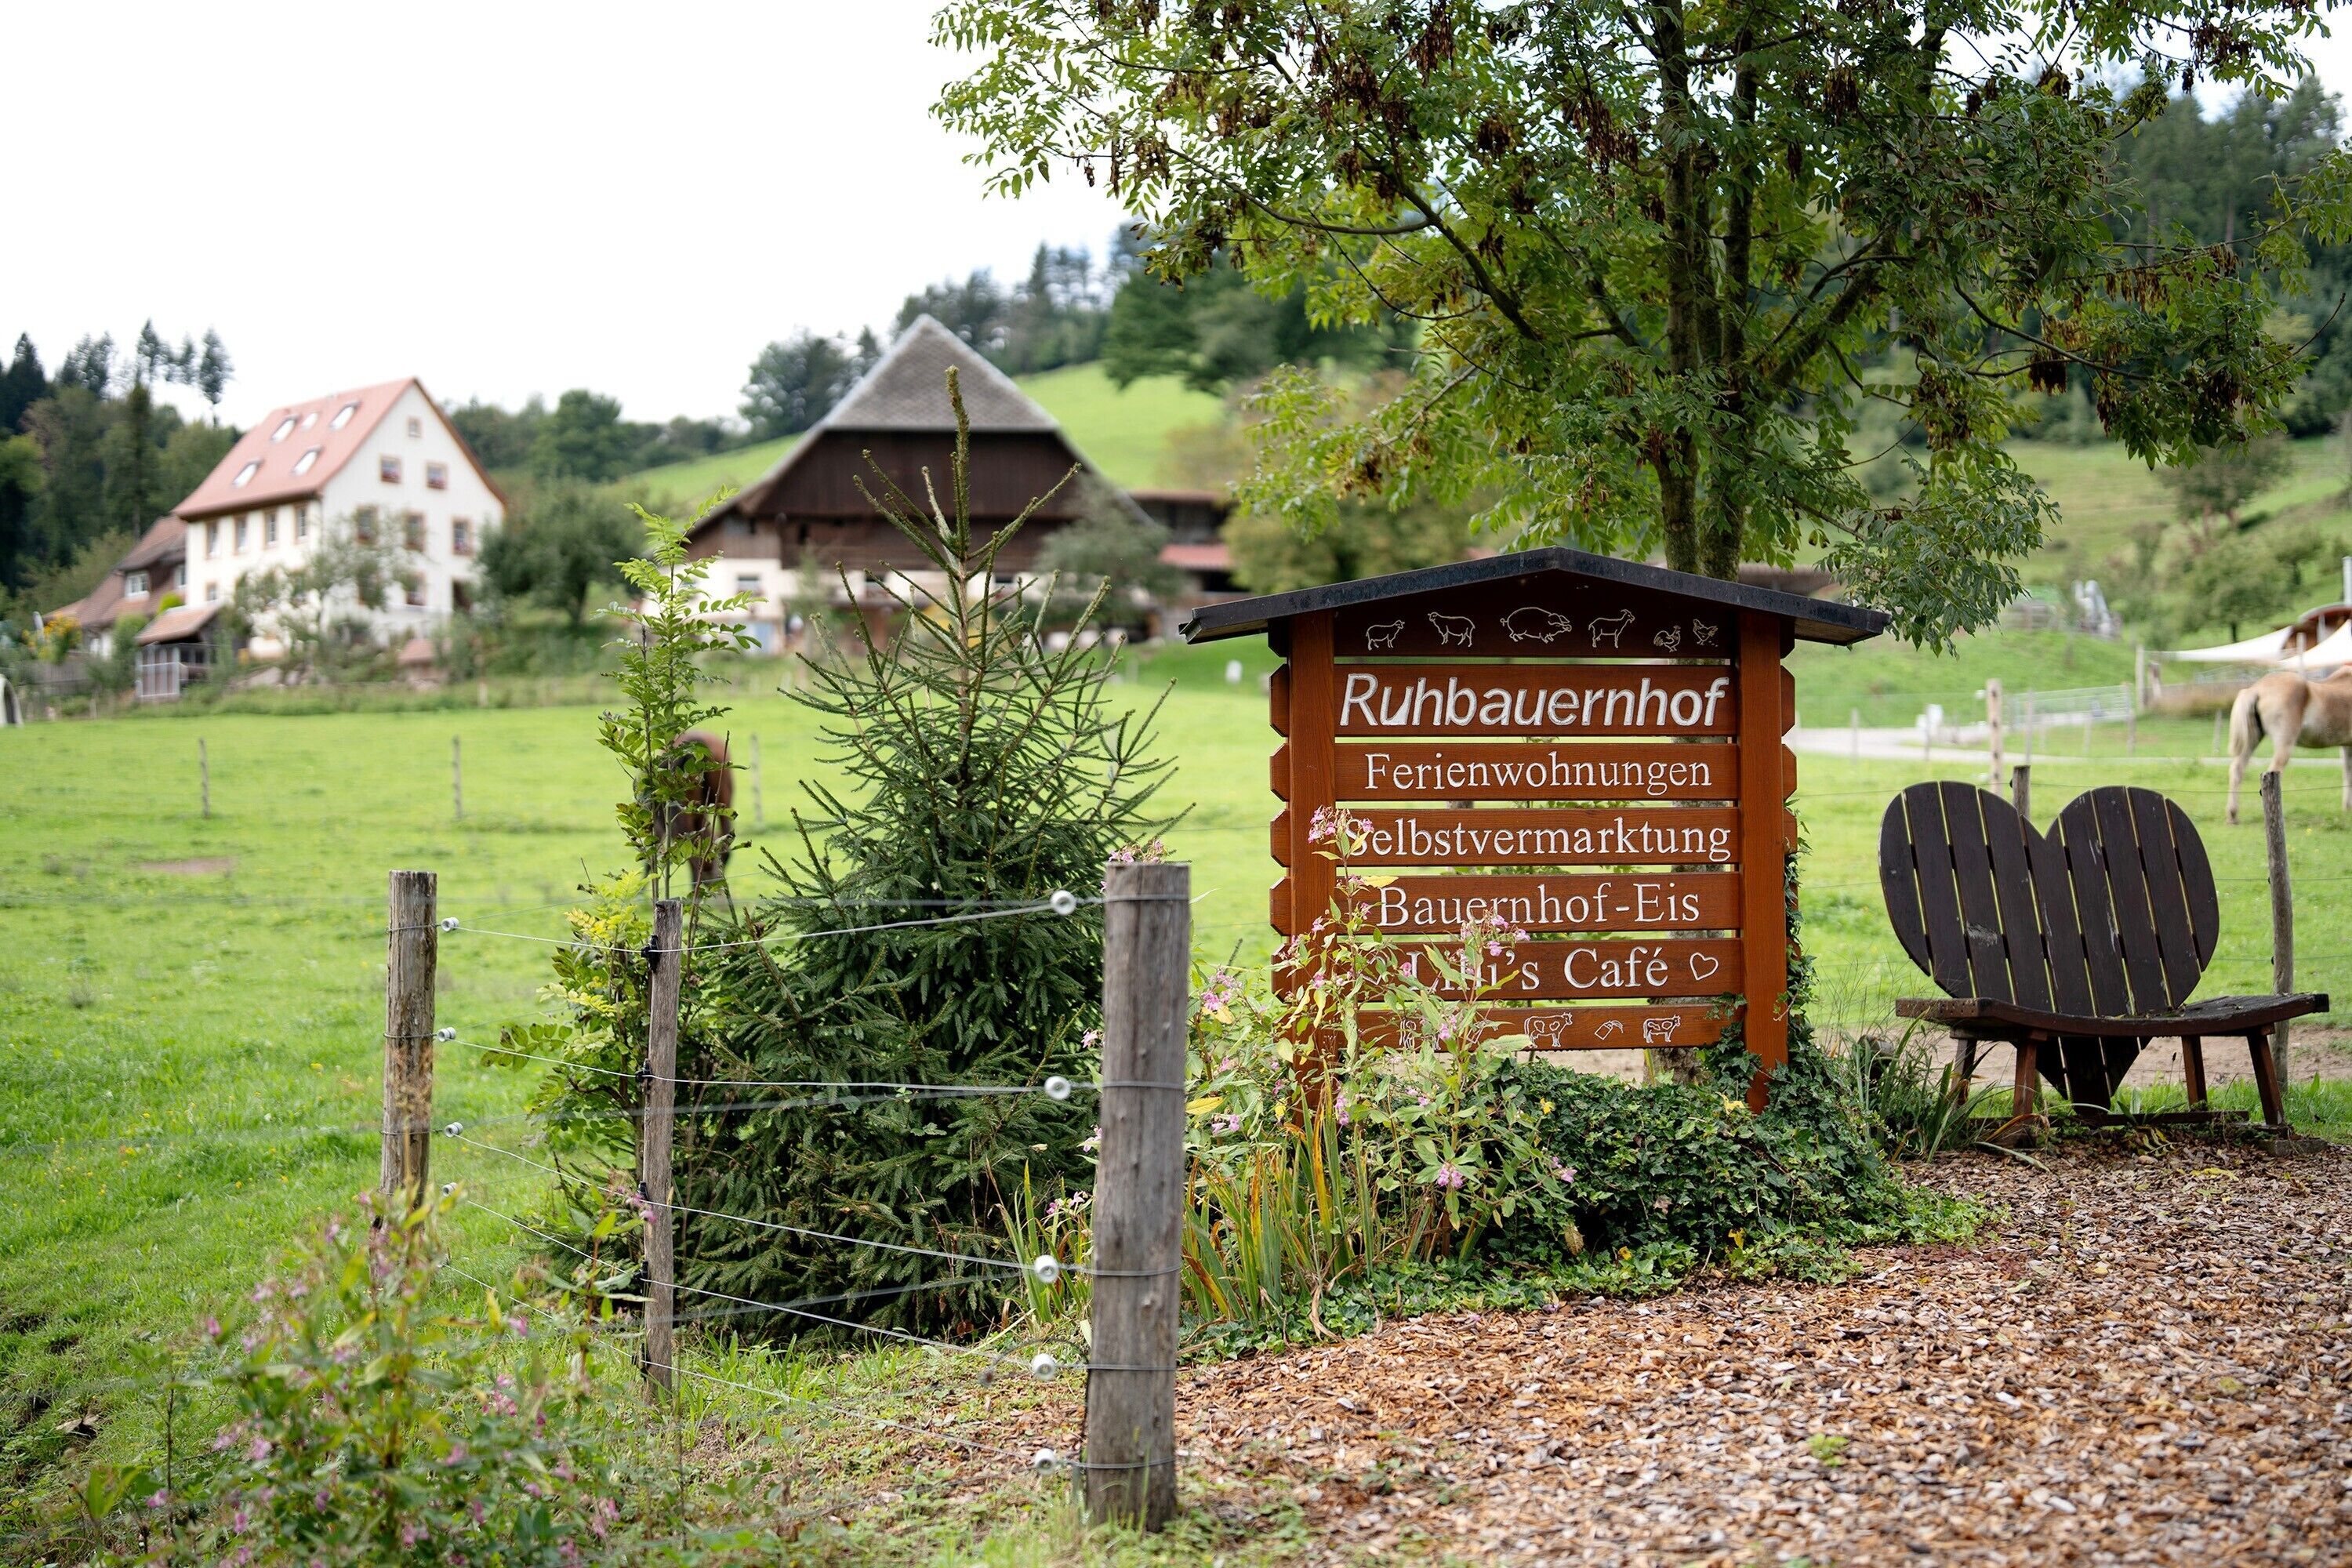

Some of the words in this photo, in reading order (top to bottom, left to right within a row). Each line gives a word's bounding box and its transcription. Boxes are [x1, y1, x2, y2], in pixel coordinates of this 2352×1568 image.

[1340, 673, 1730, 726] Ruhbauernhof
[1365, 751, 1712, 796] Ferienwohnungen
[1345, 817, 1731, 862] Selbstvermarktung
[1376, 882, 1700, 927] Bauernhof-Eis
[1563, 946, 1668, 989] Café
